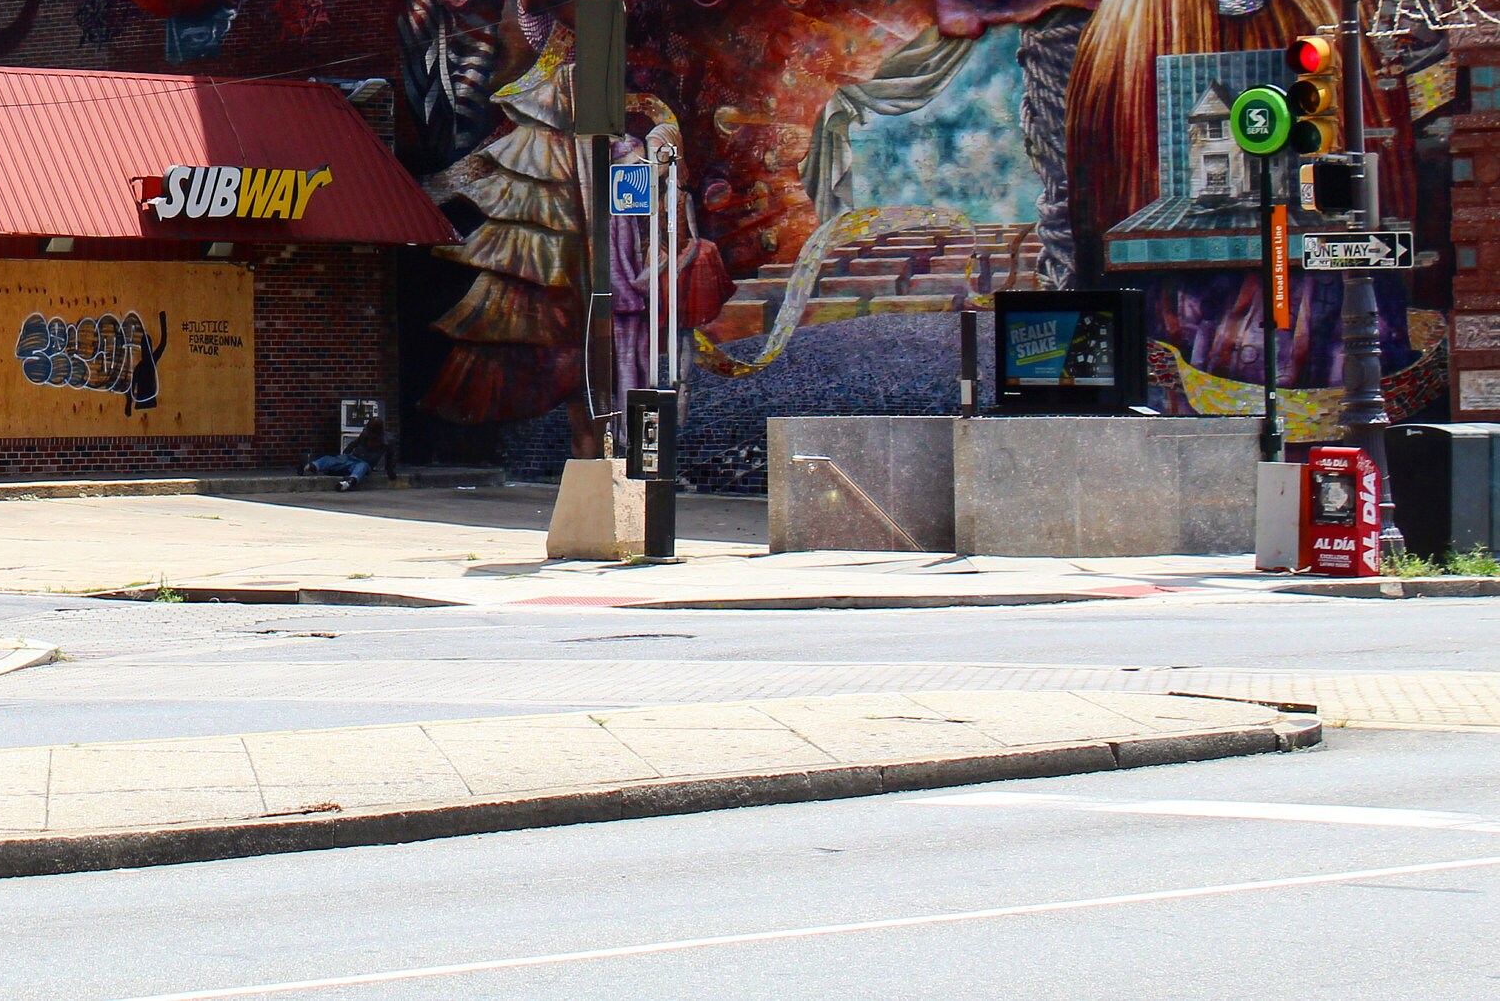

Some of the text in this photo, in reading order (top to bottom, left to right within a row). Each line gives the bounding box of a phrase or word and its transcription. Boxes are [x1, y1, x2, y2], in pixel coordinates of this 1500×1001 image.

[1246, 127, 1269, 135] SEPTA
[155, 164, 333, 222] SUBWAY
[1343, 244, 1369, 257] WAY
[1274, 225, 1284, 301] Broad Street Line
[181, 320, 229, 334] #JUSTICE
[1010, 320, 1057, 345] REALLY
[189, 344, 219, 356] TAYLOR
[1015, 337, 1057, 358] STAKE
[1359, 472, 1376, 526] DÍA
[1313, 536, 1356, 551] AL DÍA
[1363, 530, 1376, 572] AL
